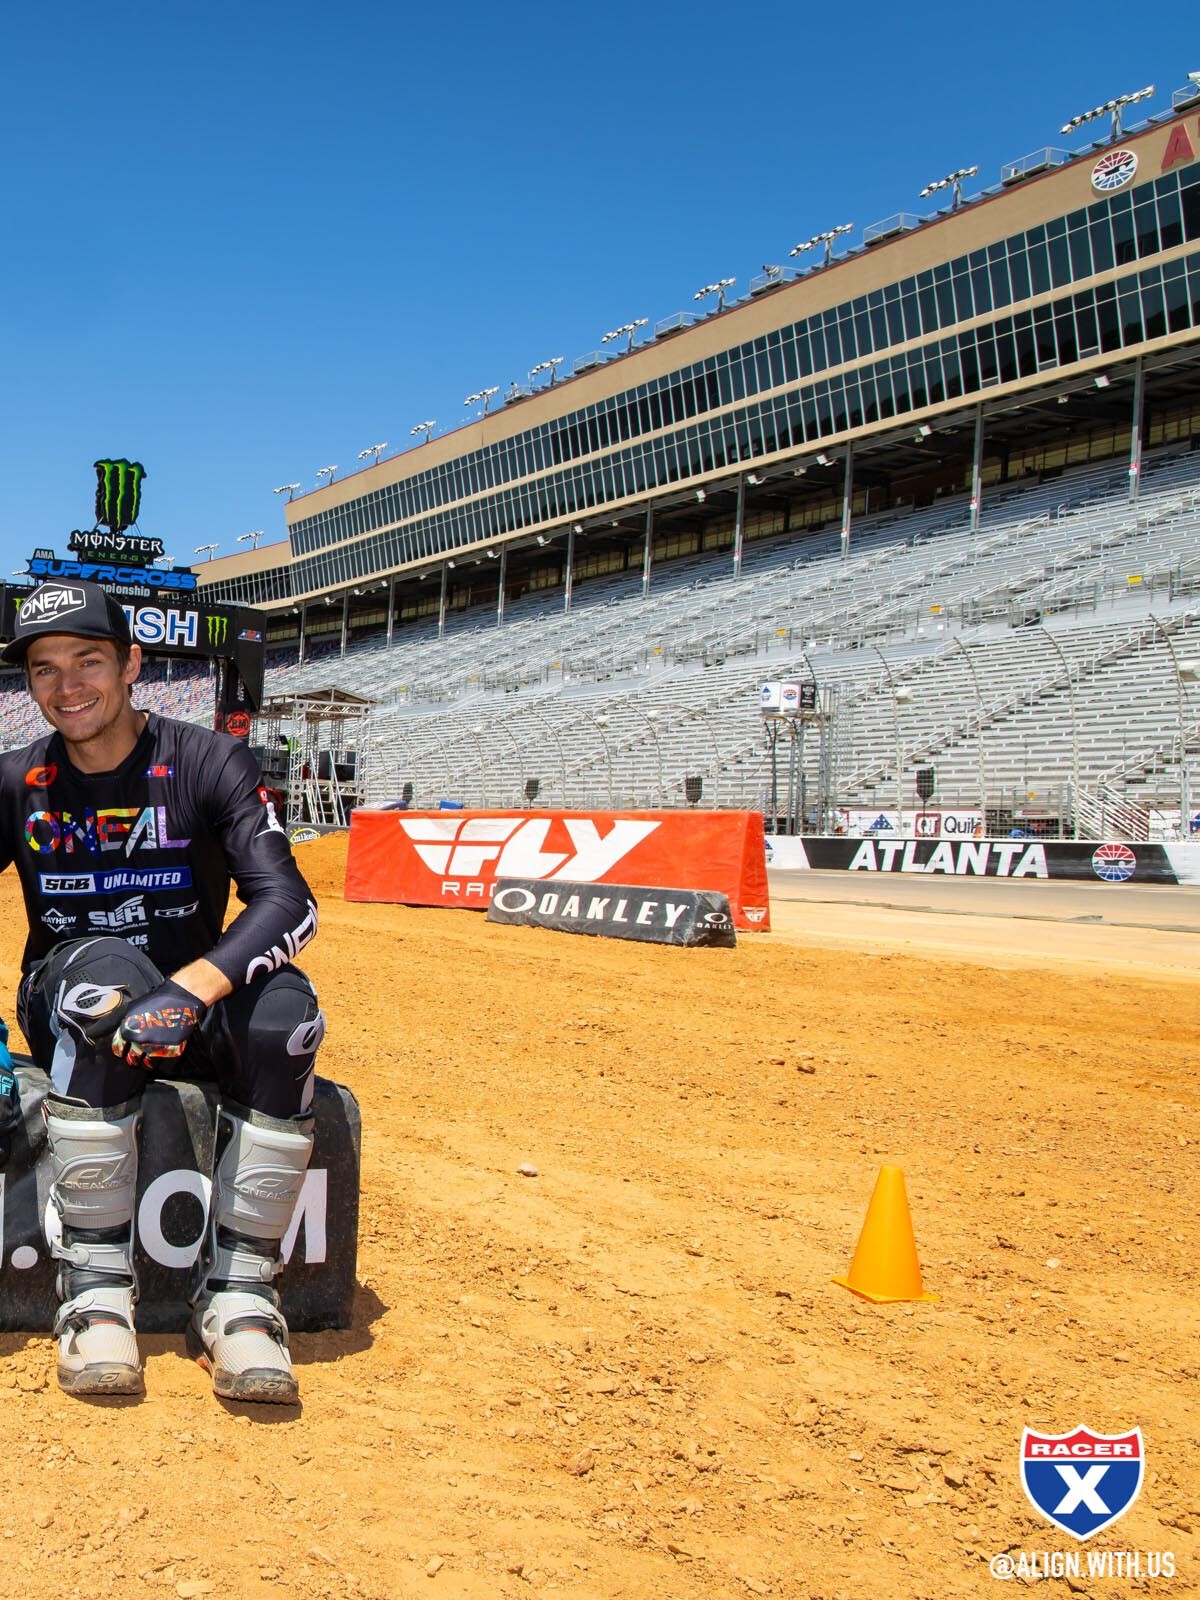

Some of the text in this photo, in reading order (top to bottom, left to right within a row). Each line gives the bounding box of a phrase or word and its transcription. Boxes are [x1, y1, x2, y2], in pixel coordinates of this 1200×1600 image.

[74, 532, 163, 554] MONSTER
[35, 550, 54, 560] AMA
[87, 550, 149, 562] ENERGY
[30, 559, 197, 590] SUPERCROSS
[399, 817, 664, 883] FLY
[848, 840, 1049, 879] ATLANTA
[44, 871, 182, 891] SGB UNLIMITED
[40, 914, 77, 926] MAYHEW
[538, 896, 686, 928] OAKLEY
